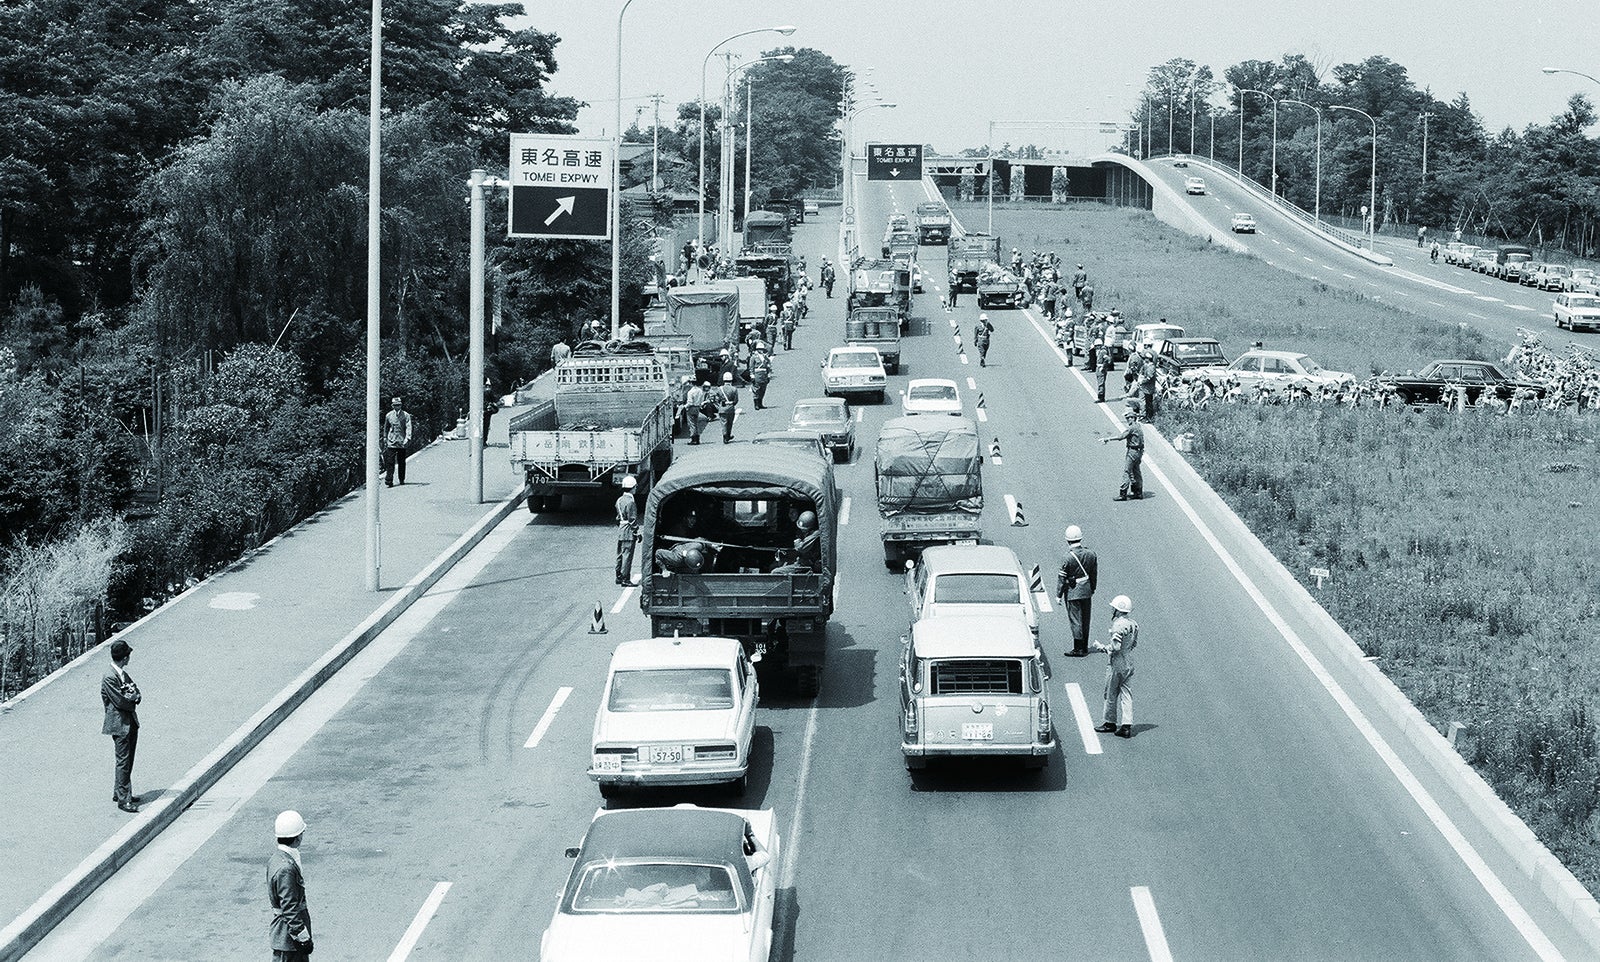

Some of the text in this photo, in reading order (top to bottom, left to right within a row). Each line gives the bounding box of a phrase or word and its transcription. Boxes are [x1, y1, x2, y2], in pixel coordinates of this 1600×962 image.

[873, 147, 917, 157] 東名高速
[521, 148, 602, 168] 東名高速
[523, 172, 599, 183] TOMEI EXPWY
